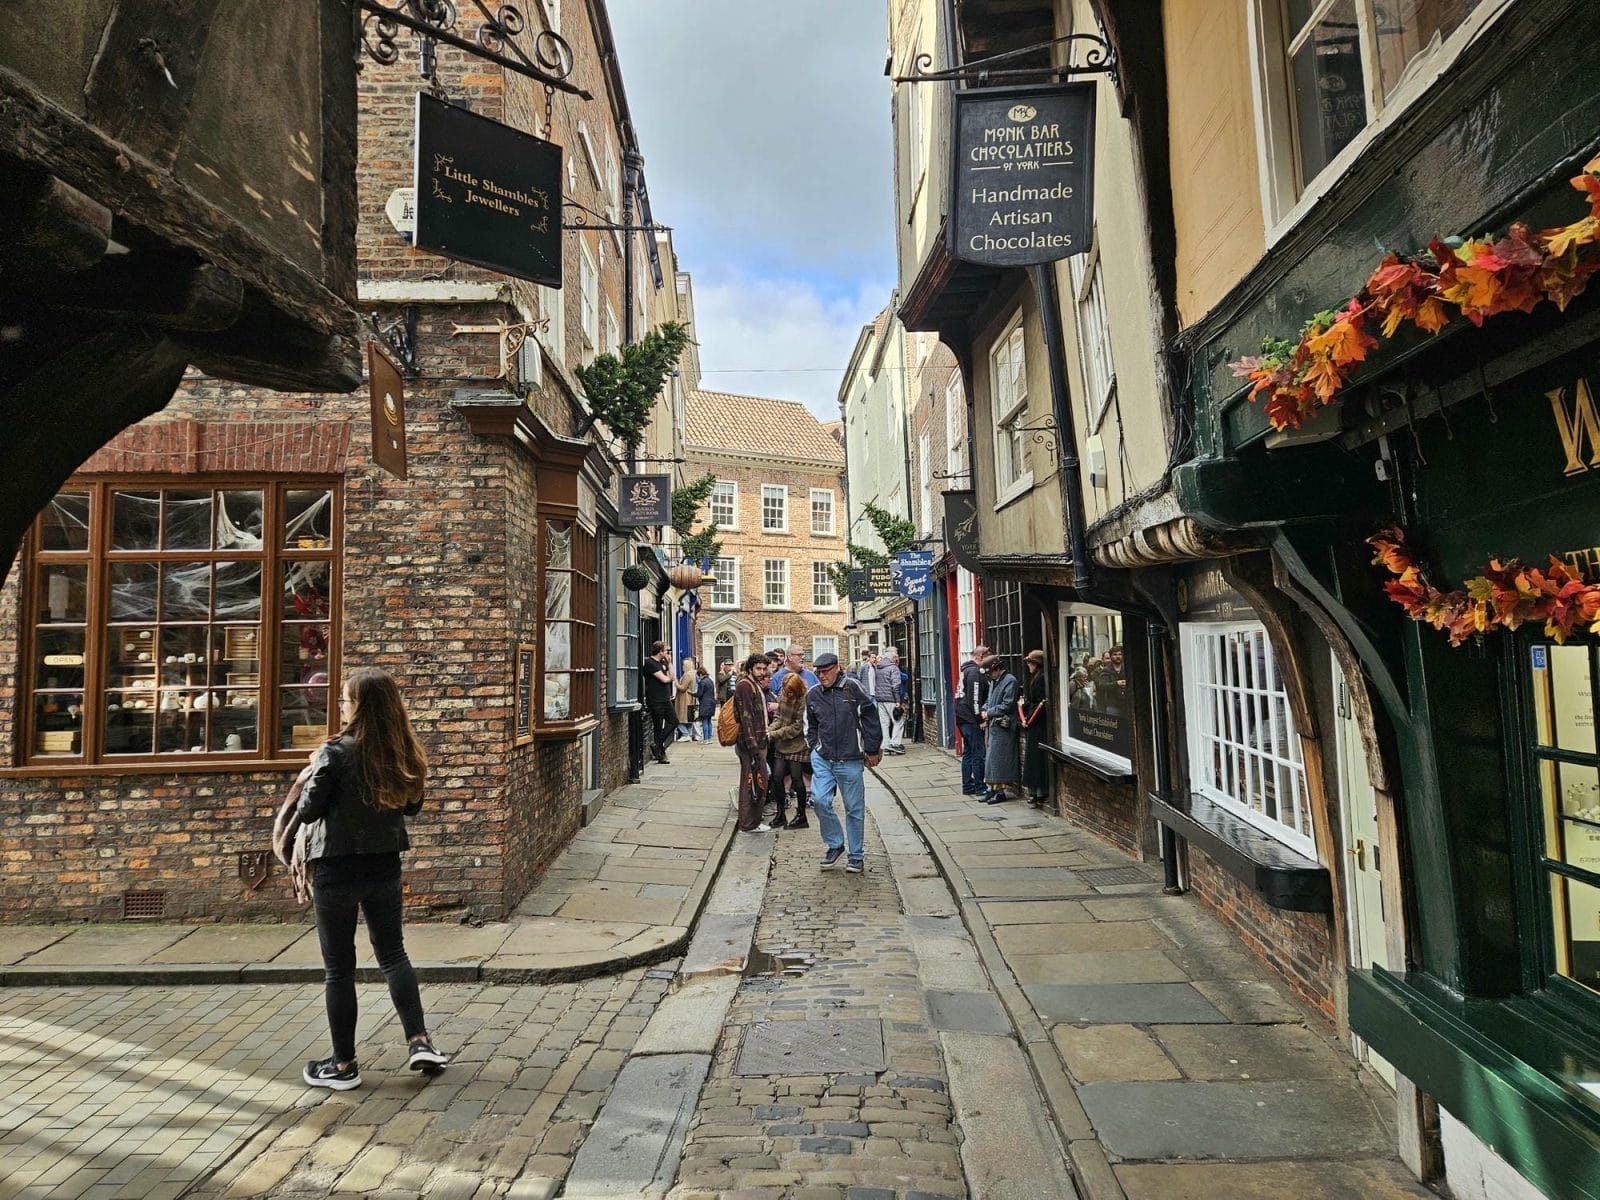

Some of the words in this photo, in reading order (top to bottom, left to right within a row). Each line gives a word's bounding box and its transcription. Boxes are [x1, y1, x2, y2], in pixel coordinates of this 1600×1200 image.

[984, 126, 1025, 143] MONK
[1031, 124, 1060, 140] BAR
[970, 141, 1073, 162] CHOCOLATIERS
[1016, 161, 1040, 171] YORK
[444, 166, 478, 187] Little
[482, 179, 540, 208] Shambles
[972, 182, 1073, 204] Handmade
[465, 189, 520, 217] Jewellers
[989, 209, 1053, 226] Artisan
[970, 231, 1072, 251] Chocolates
[900, 558, 931, 566] Shambles
[904, 573, 927, 587] Sweet
[908, 584, 925, 595] Shop
